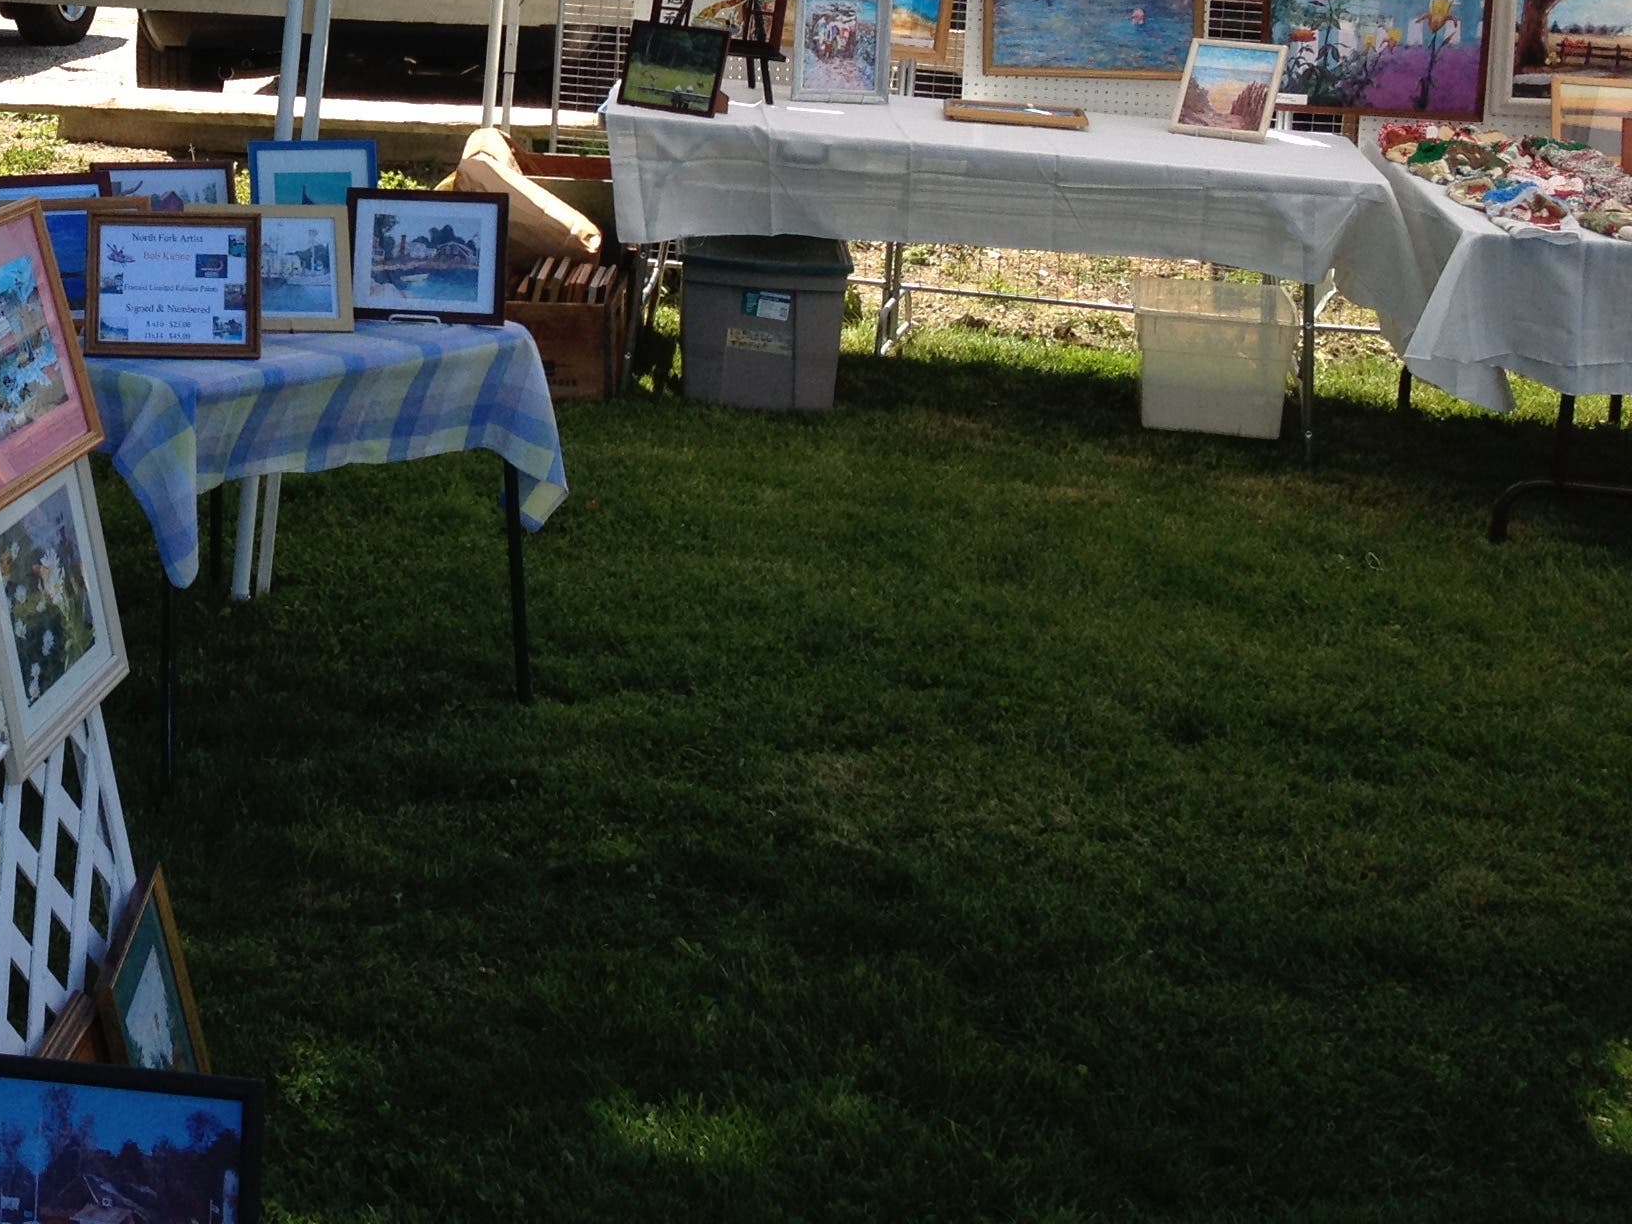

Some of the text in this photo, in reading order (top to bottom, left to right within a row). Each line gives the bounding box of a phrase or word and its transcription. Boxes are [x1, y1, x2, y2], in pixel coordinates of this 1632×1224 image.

[132, 232, 204, 243] North Fork Artist
[126, 303, 154, 314] Signed
[167, 304, 211, 314] Numbered
